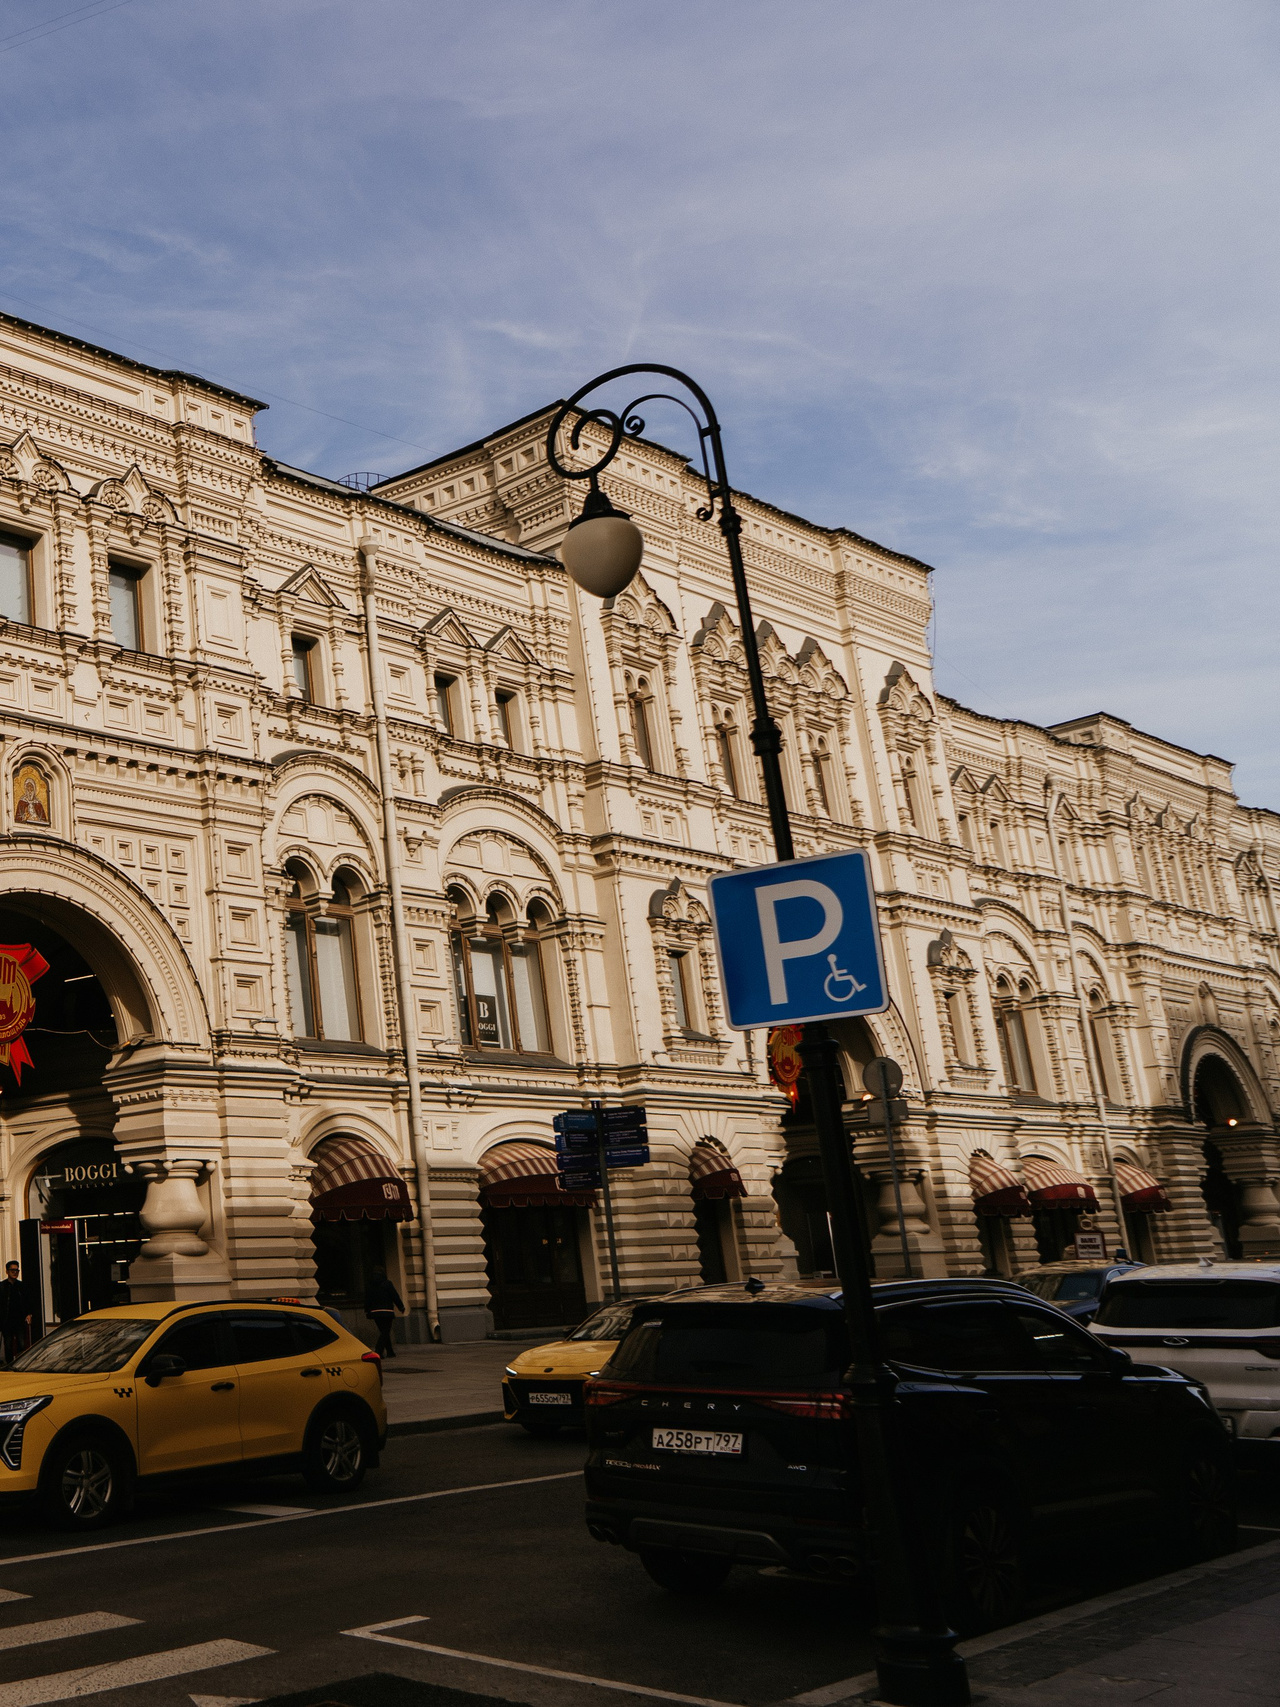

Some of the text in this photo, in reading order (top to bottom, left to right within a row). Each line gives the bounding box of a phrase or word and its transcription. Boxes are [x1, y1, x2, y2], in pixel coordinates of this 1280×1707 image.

[754, 878, 844, 1006] P
[478, 1022, 496, 1031] OGGI
[64, 1162, 118, 1182] BOGGI
[641, 1400, 741, 1411] CHERY
[716, 1433, 739, 1447] 797
